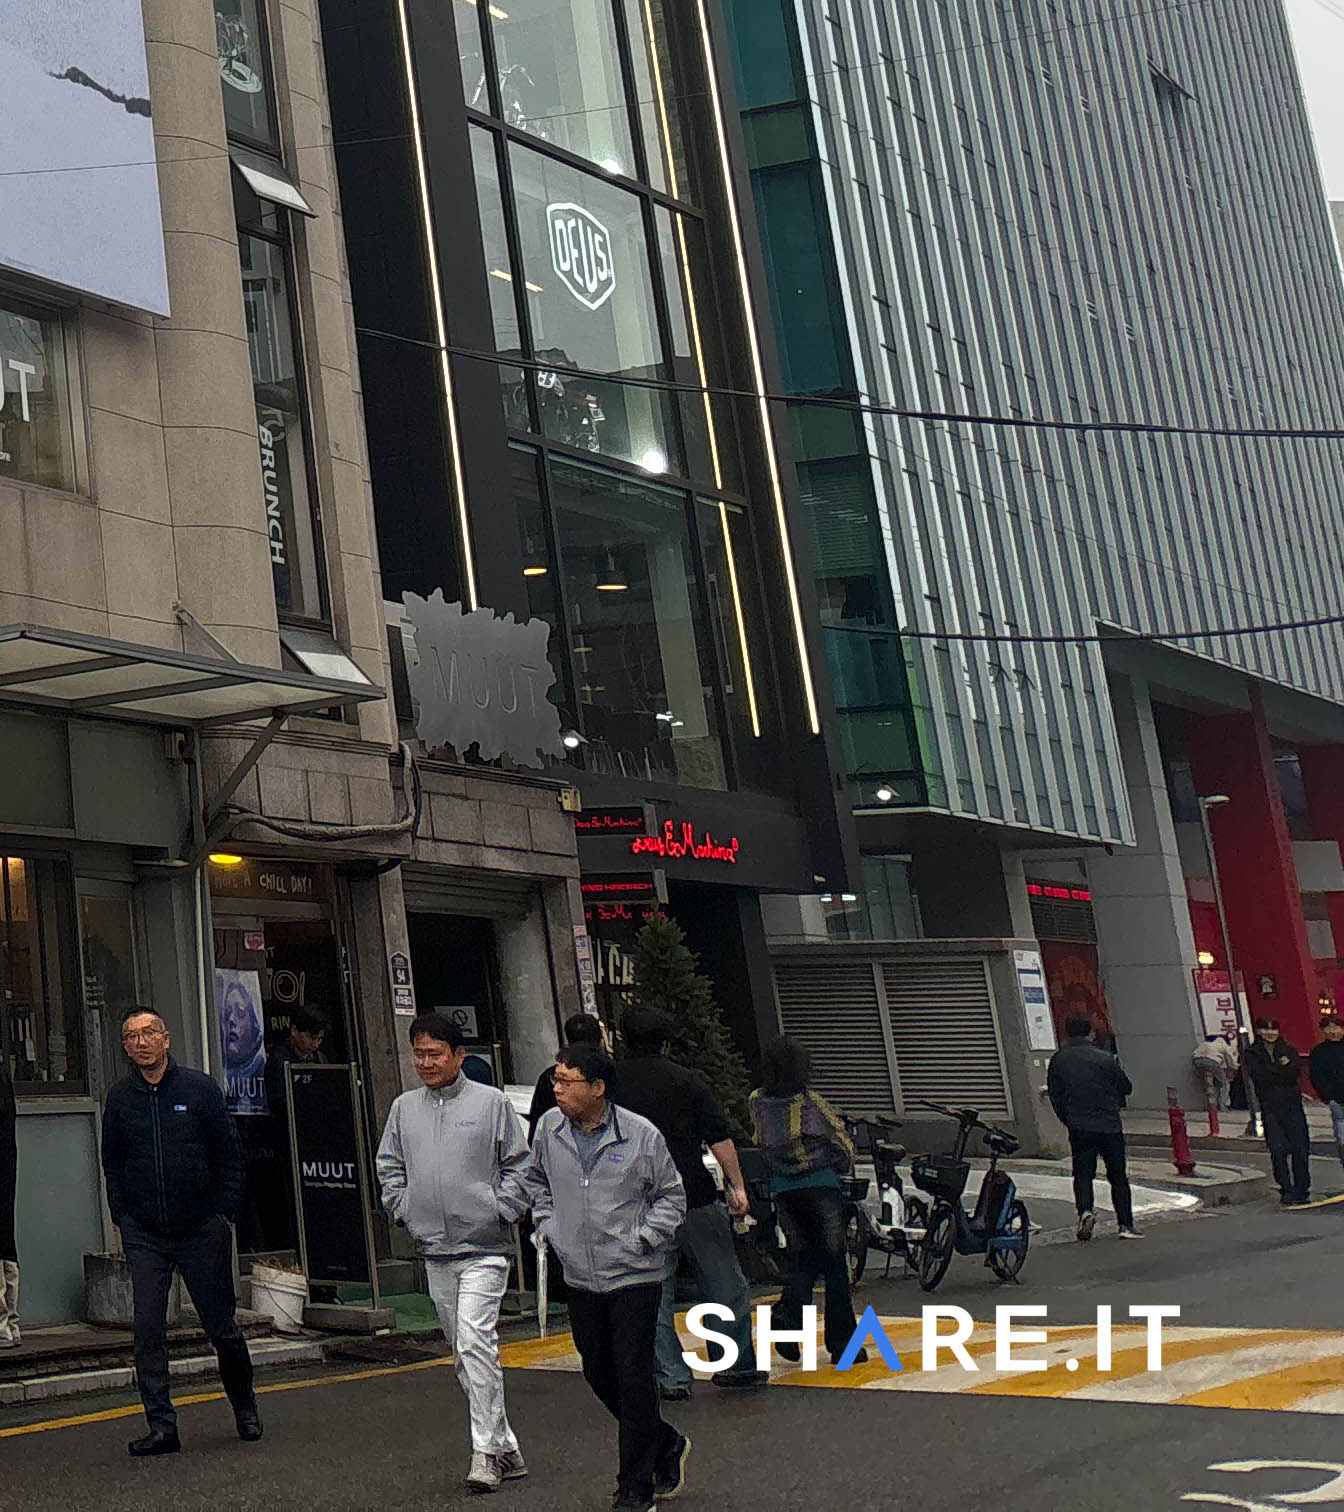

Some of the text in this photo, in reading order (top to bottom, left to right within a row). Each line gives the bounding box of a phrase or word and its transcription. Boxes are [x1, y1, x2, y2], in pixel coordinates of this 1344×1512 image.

[554, 218, 608, 293] DEUS
[258, 424, 286, 565] BRUNCH
[302, 1161, 355, 1179] MUUT
